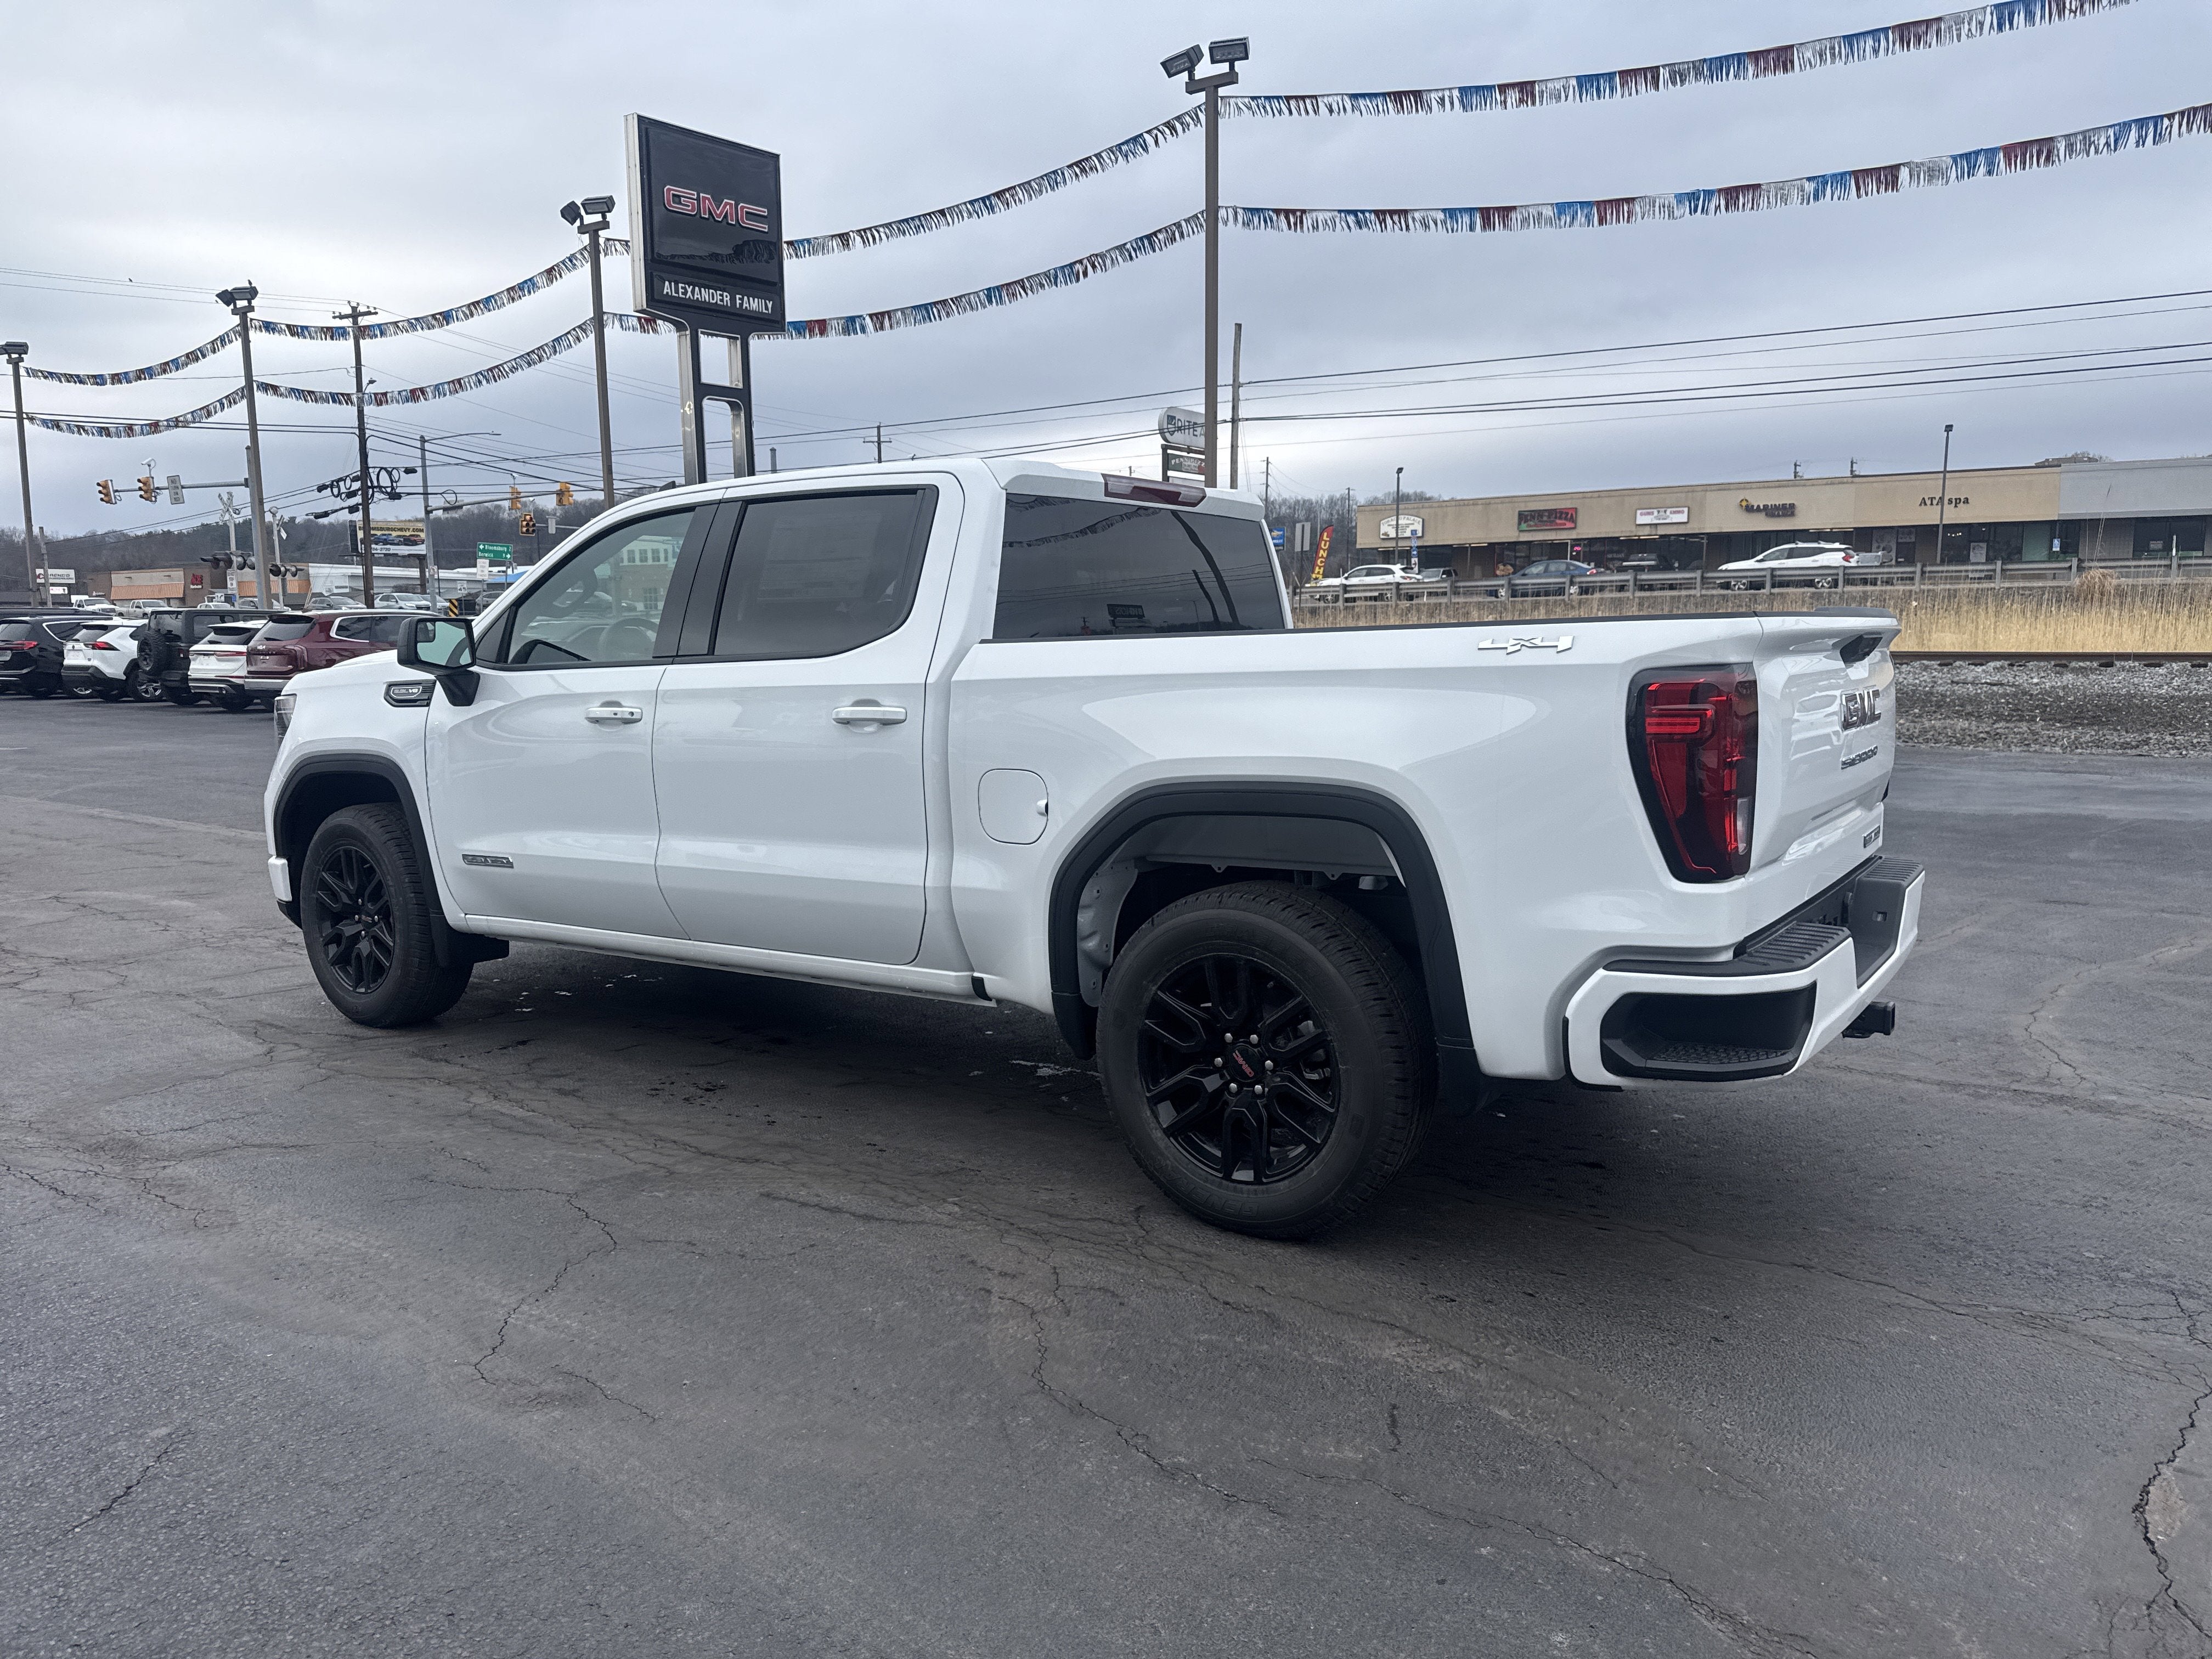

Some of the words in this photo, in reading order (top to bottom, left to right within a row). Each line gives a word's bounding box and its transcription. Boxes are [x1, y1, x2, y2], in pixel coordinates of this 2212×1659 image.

[664, 185, 768, 232] GMC
[663, 281, 731, 307] ALEXANDER
[736, 294, 773, 314] FAMILY
[1190, 458, 1205, 467] PIZZ
[1745, 503, 1795, 513] MARINER
[1918, 496, 1943, 506] ATA
[1948, 496, 1970, 508] spa
[1381, 517, 1403, 526] TOBACO
[1841, 689, 1882, 732] GMC
[1233, 1050, 1255, 1077] GMC
